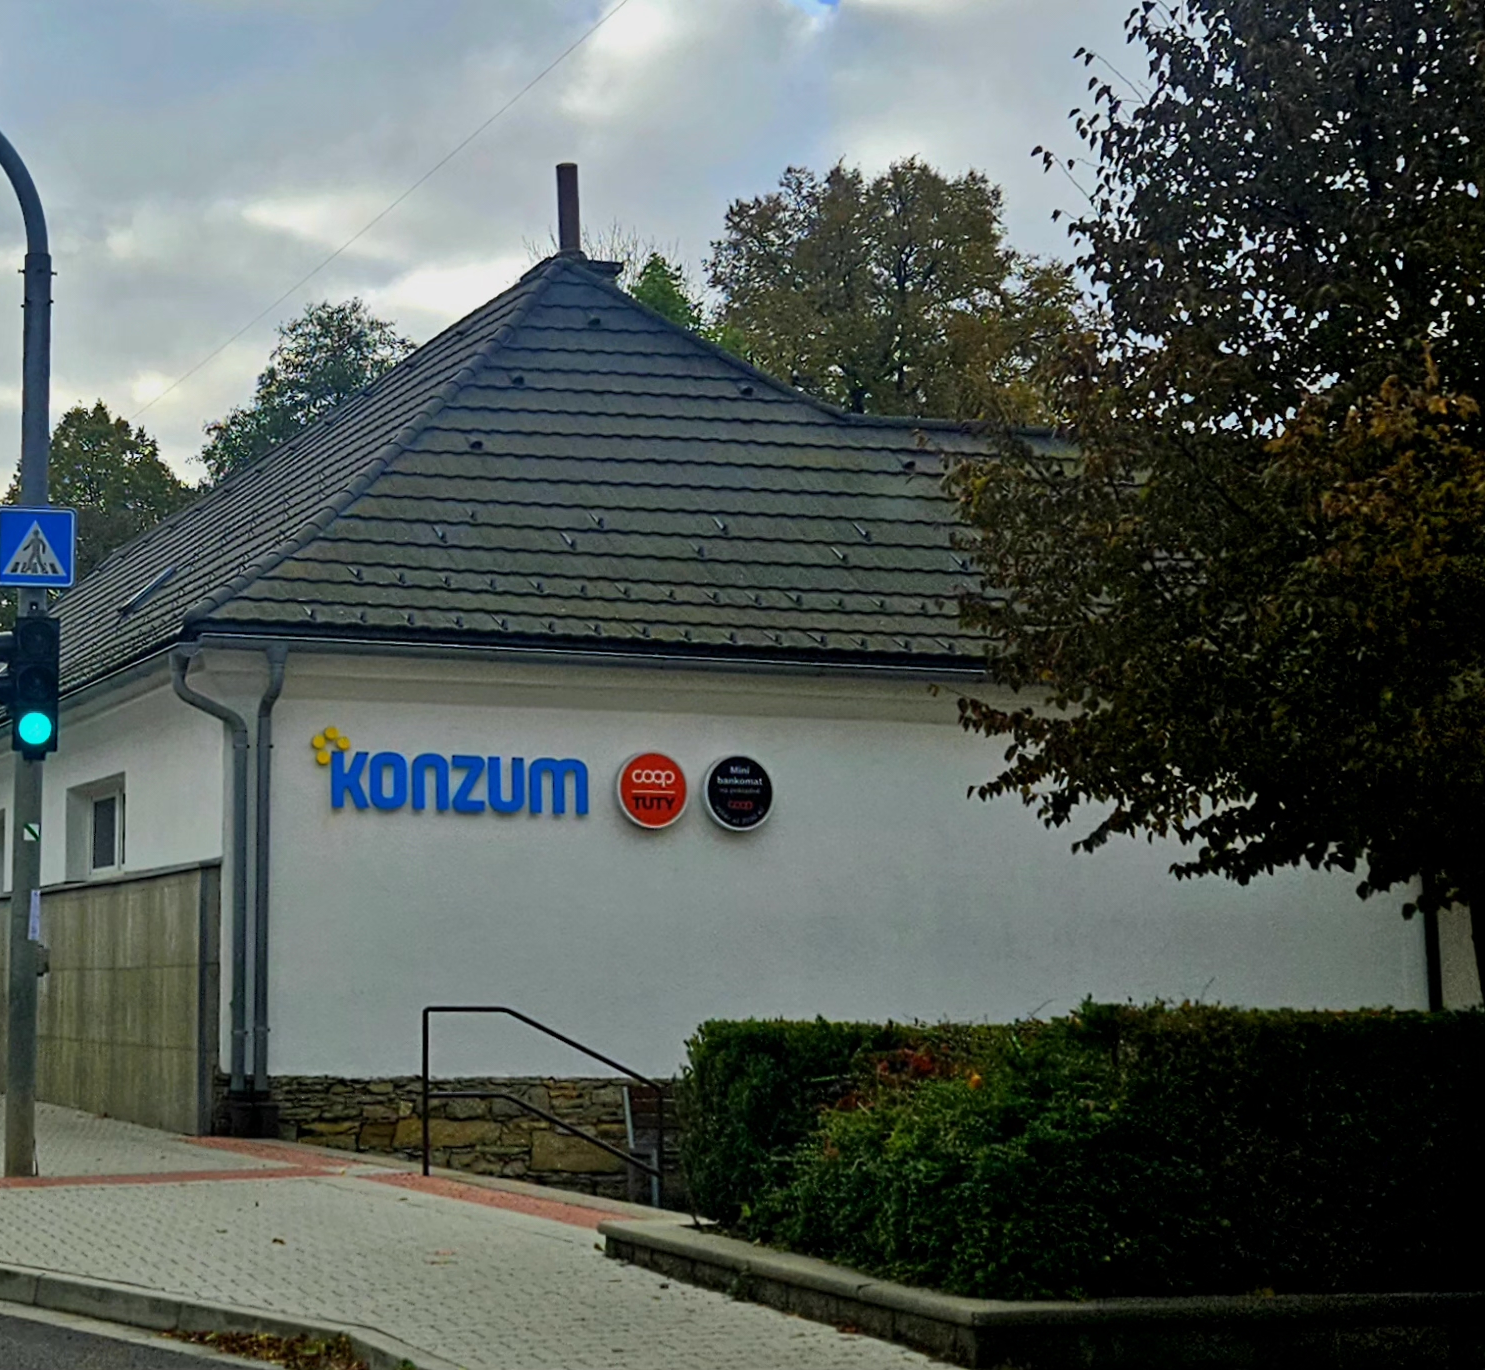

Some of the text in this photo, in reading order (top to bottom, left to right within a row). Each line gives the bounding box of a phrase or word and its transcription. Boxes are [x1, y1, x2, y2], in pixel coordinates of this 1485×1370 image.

[730, 766, 750, 774] Mini
[717, 776, 763, 786] bankomat
[633, 797, 675, 810] TUTY
